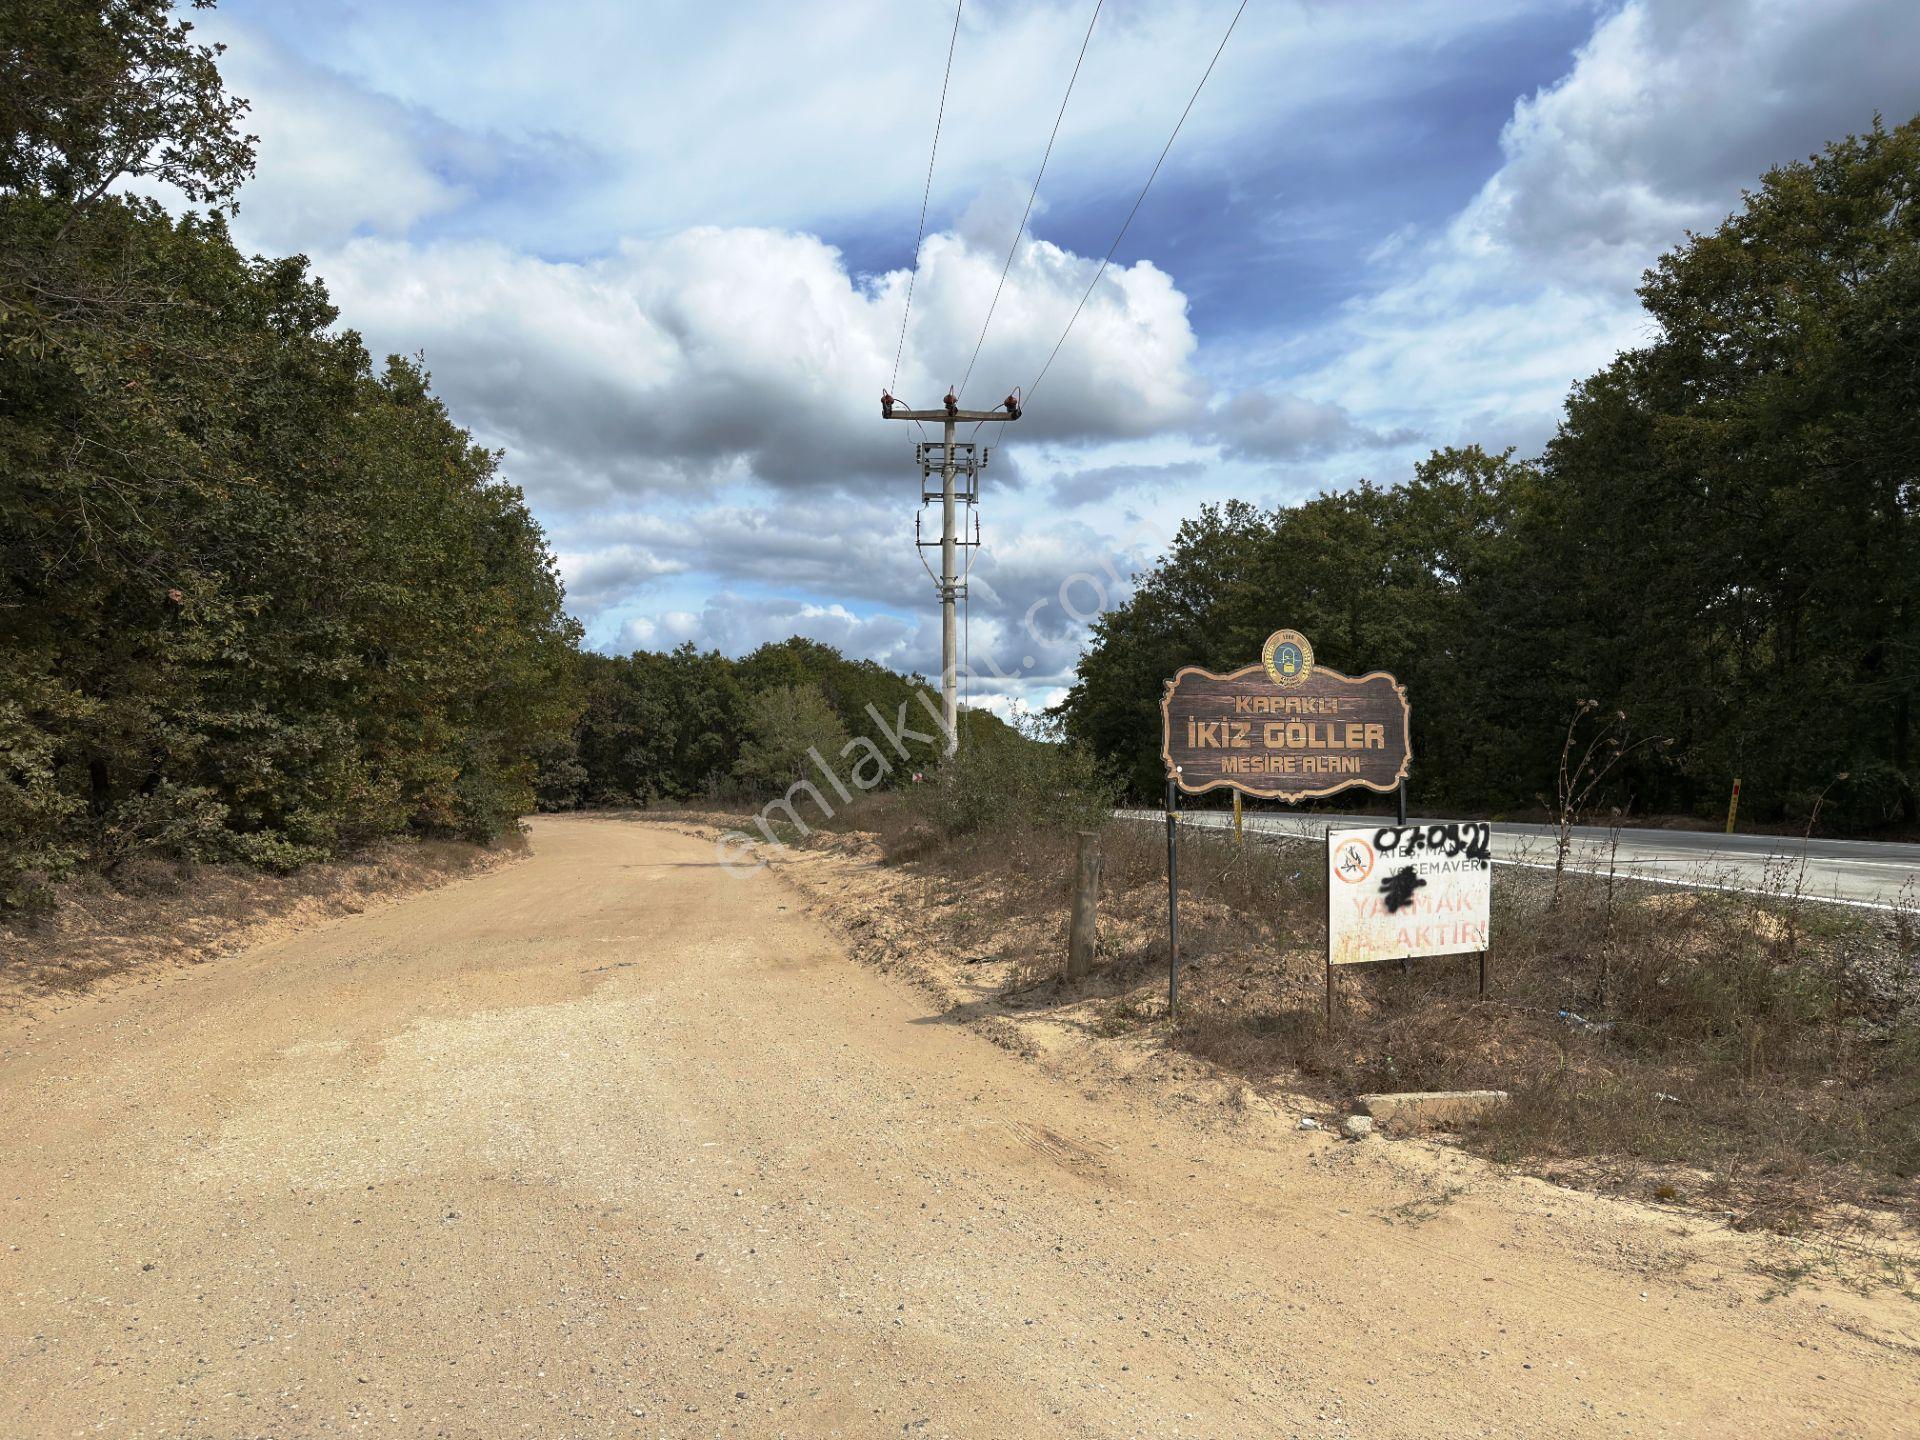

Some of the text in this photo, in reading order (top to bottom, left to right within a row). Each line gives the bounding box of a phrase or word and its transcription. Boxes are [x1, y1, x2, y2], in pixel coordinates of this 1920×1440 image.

[1234, 695, 1339, 714] KAPAKLI
[1187, 715, 1385, 749] İKİZ GÖLLER
[1221, 752, 1361, 773] MESİRE ALANI
[1410, 858, 1480, 876] SEMAVER
